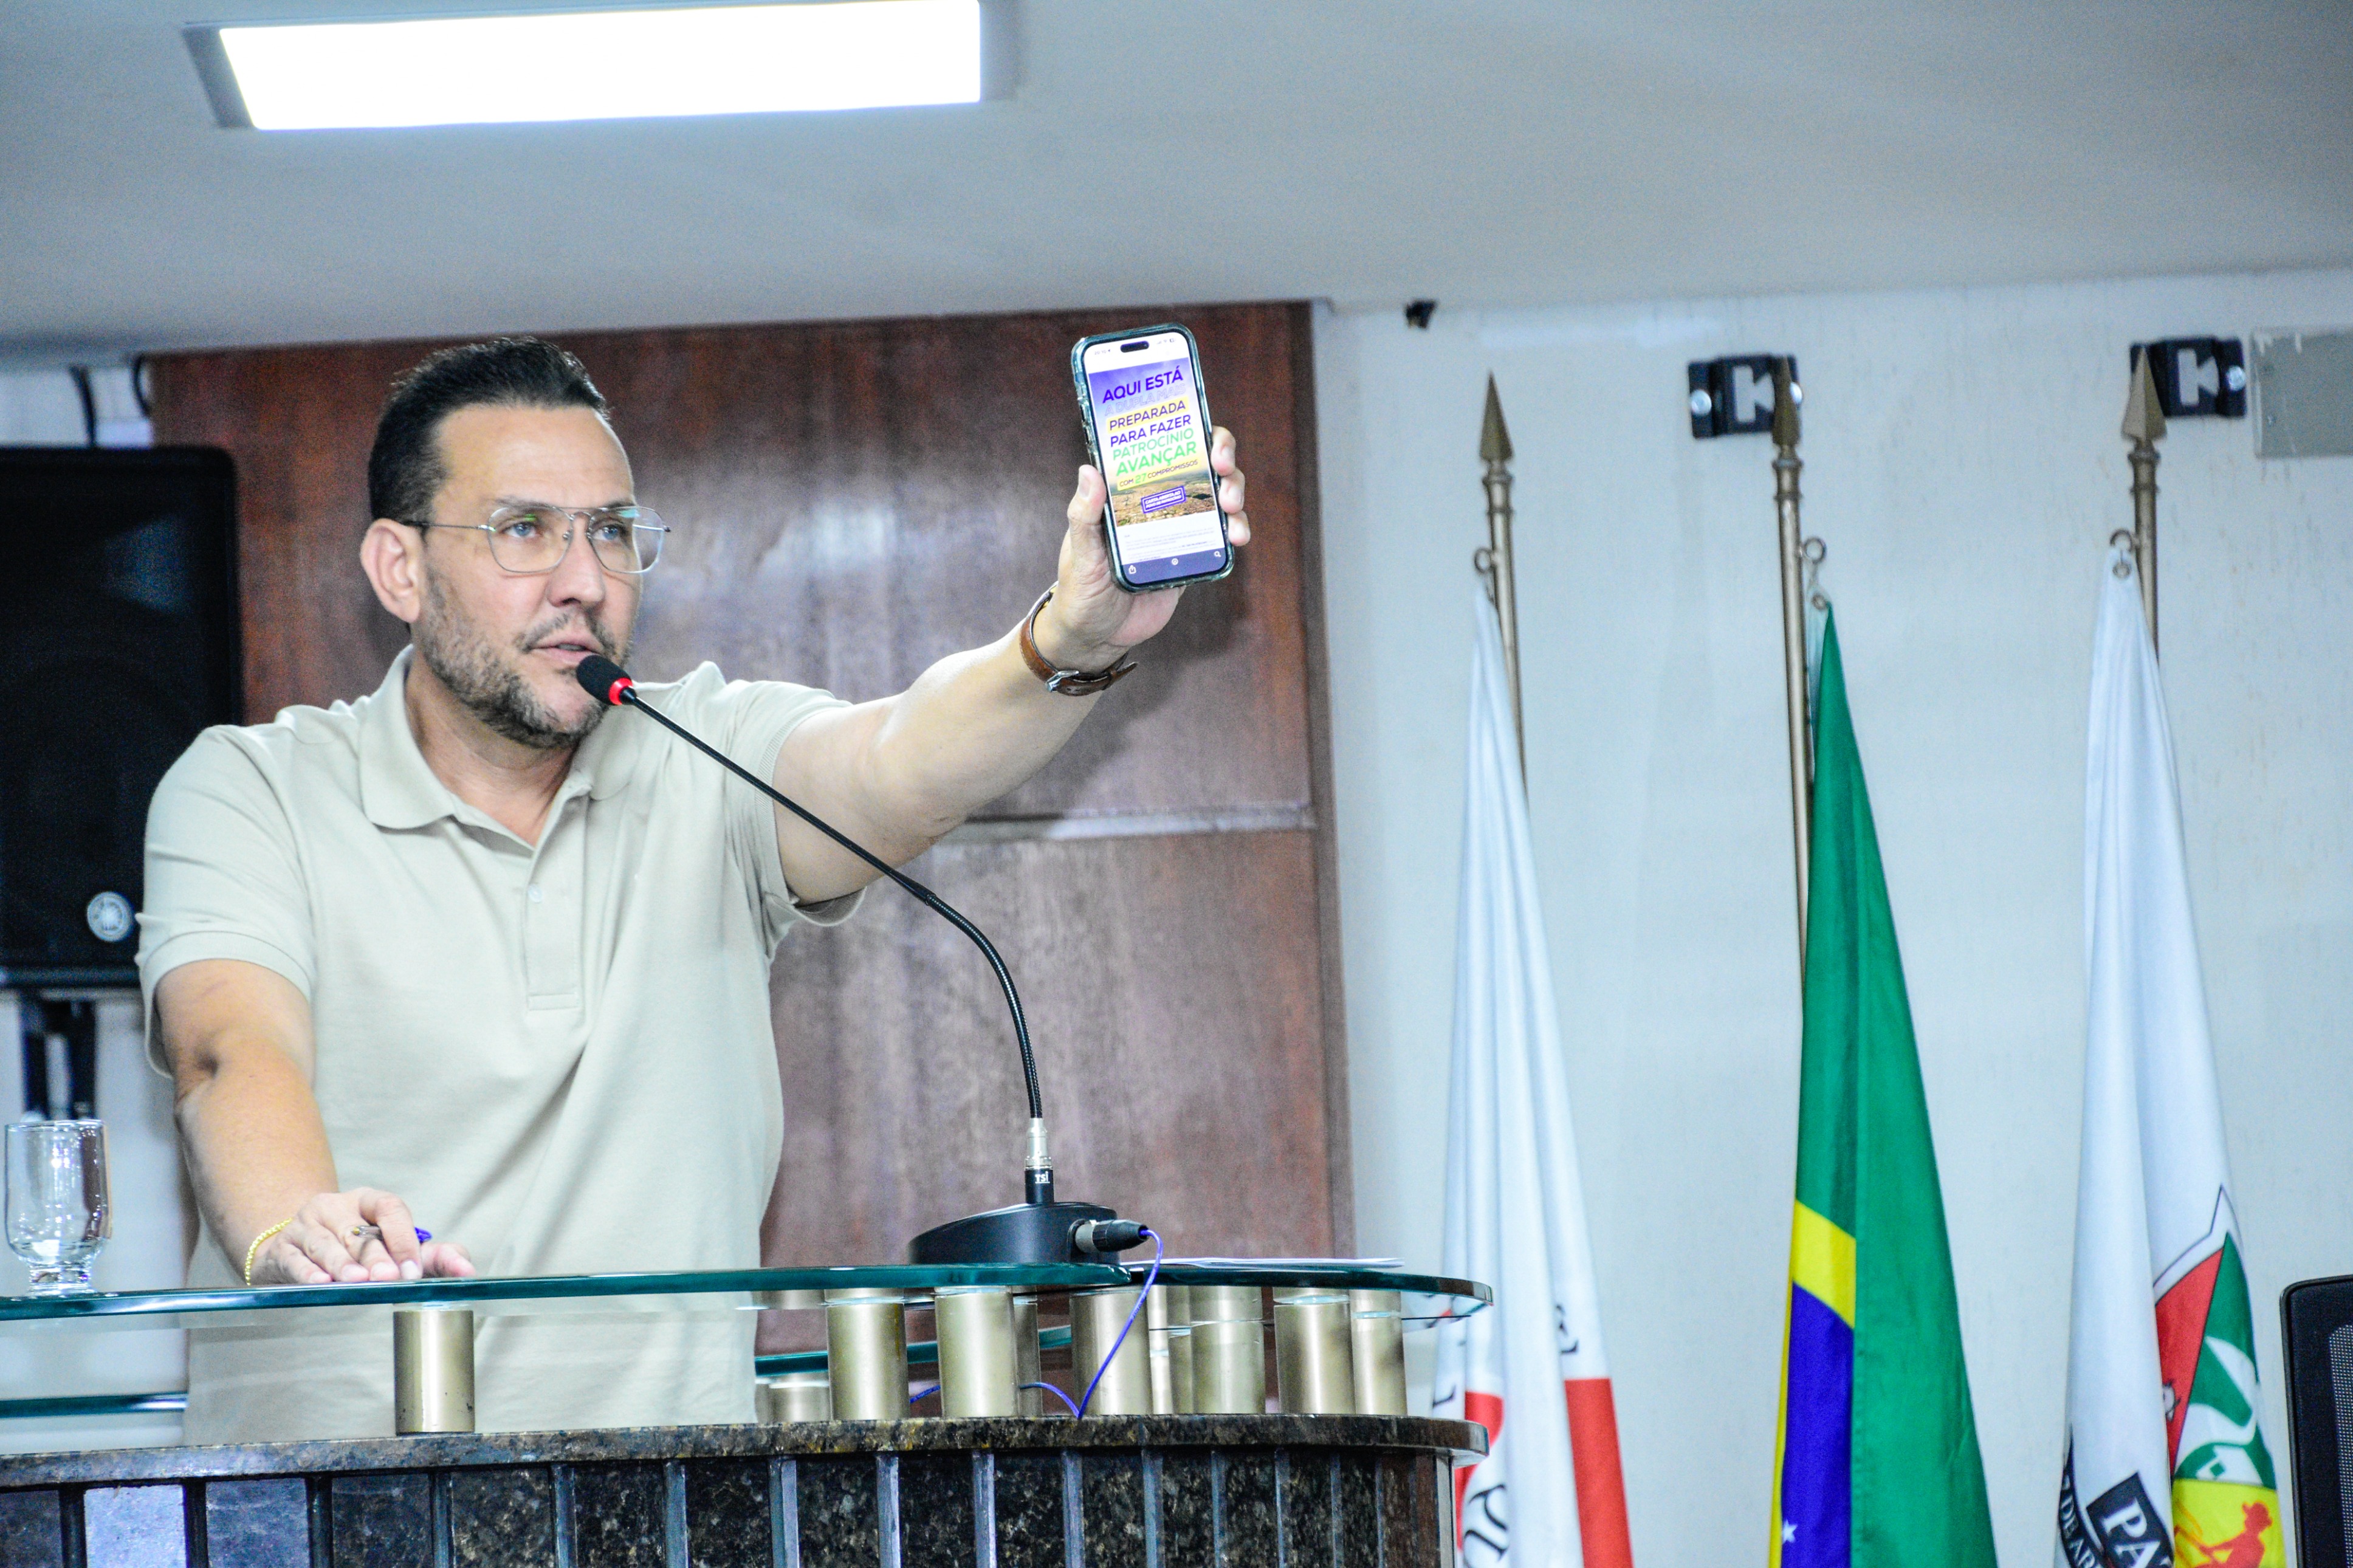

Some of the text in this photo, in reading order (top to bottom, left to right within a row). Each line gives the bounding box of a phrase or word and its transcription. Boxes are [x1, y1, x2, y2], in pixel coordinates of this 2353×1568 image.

[1102, 365, 1183, 403] AQUI ESTÁ
[1105, 383, 1186, 416] A DUPLA MAIS
[1109, 400, 1186, 431] PREPARADA
[1110, 414, 1191, 447] PARA FAZER
[1113, 428, 1194, 461] PATROCÍNIO
[1116, 440, 1197, 476] AVANÇAR
[1119, 459, 1198, 487] COM 27 COMPROMISSOS
[2101, 1498, 2174, 1568] PA
